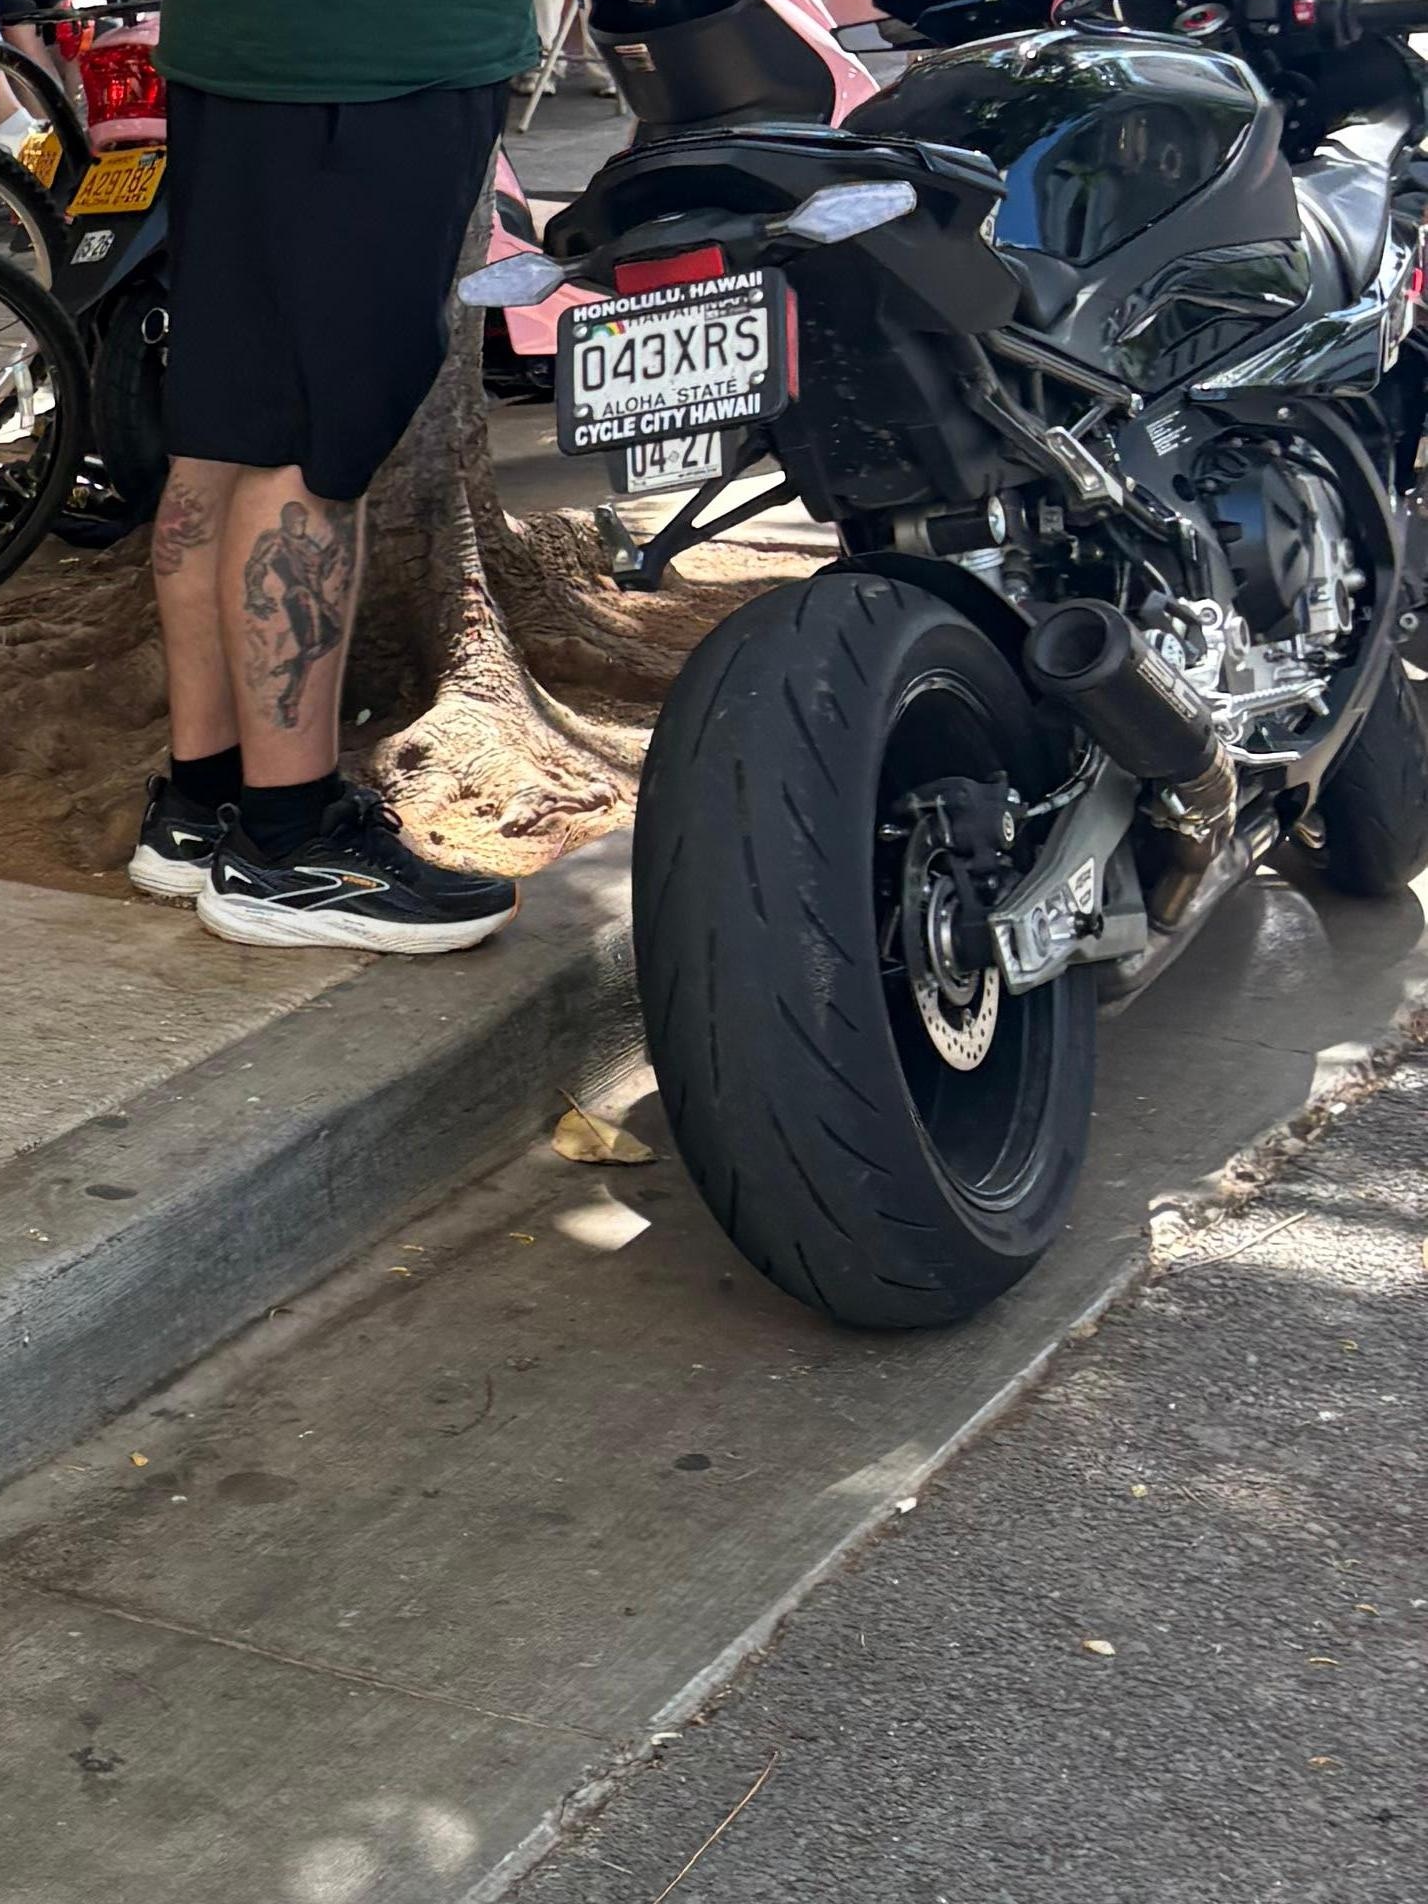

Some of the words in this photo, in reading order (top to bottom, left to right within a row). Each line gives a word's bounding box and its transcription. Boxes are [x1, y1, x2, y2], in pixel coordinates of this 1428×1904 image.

[81, 167, 156, 196] A29782
[690, 271, 763, 299] HAWAII
[582, 316, 760, 392] 043XRS
[602, 395, 666, 417] ALOHA
[677, 379, 737, 404] STATE
[574, 420, 636, 447] CYCLE
[640, 407, 687, 434] CITY
[690, 393, 761, 424] HAWAII
